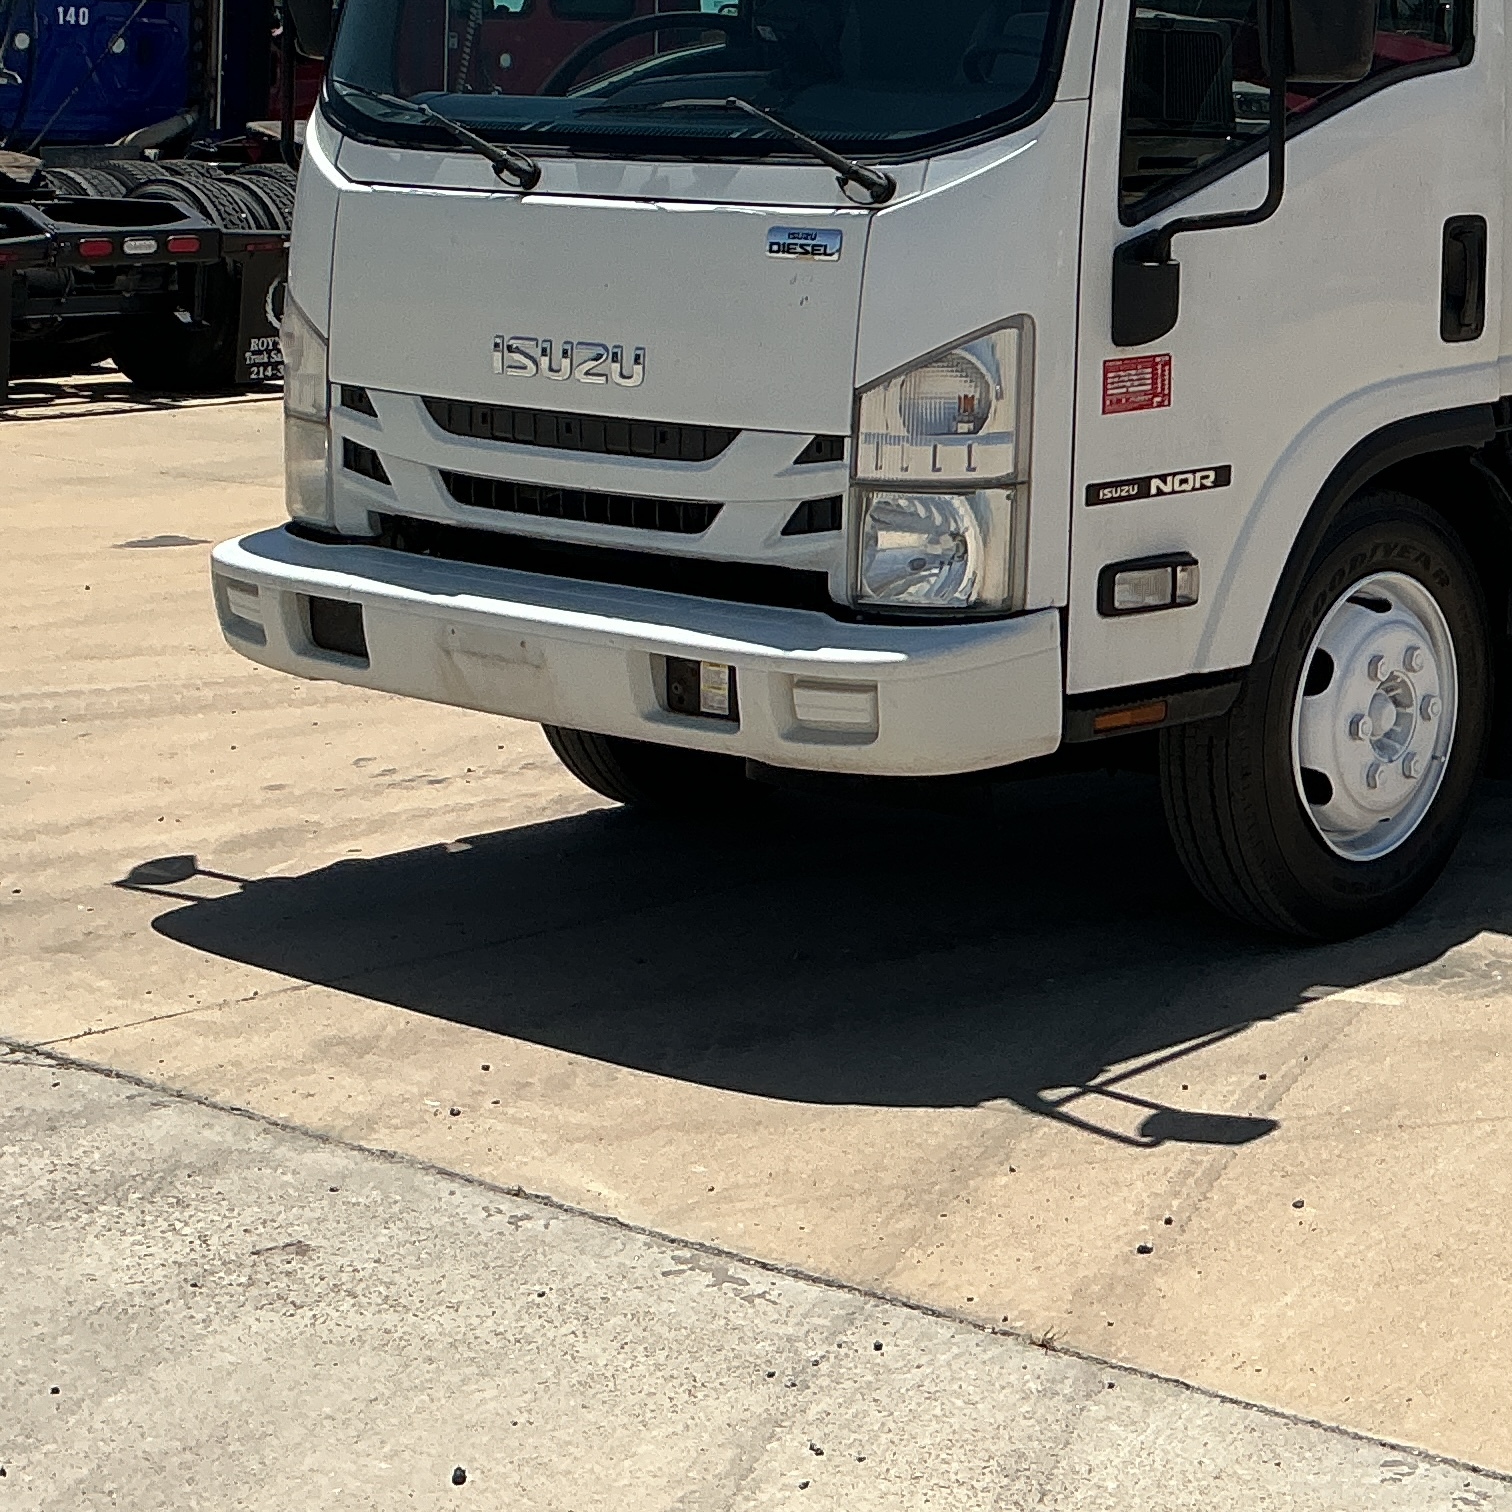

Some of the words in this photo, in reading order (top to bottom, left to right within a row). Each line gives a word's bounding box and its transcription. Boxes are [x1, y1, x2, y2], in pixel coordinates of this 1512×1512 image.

[57, 5, 89, 26] 140
[768, 241, 836, 257] DIESEL
[492, 334, 647, 388] ISUZU
[1099, 484, 1139, 500] ISUZU
[1149, 470, 1216, 496] NQR
